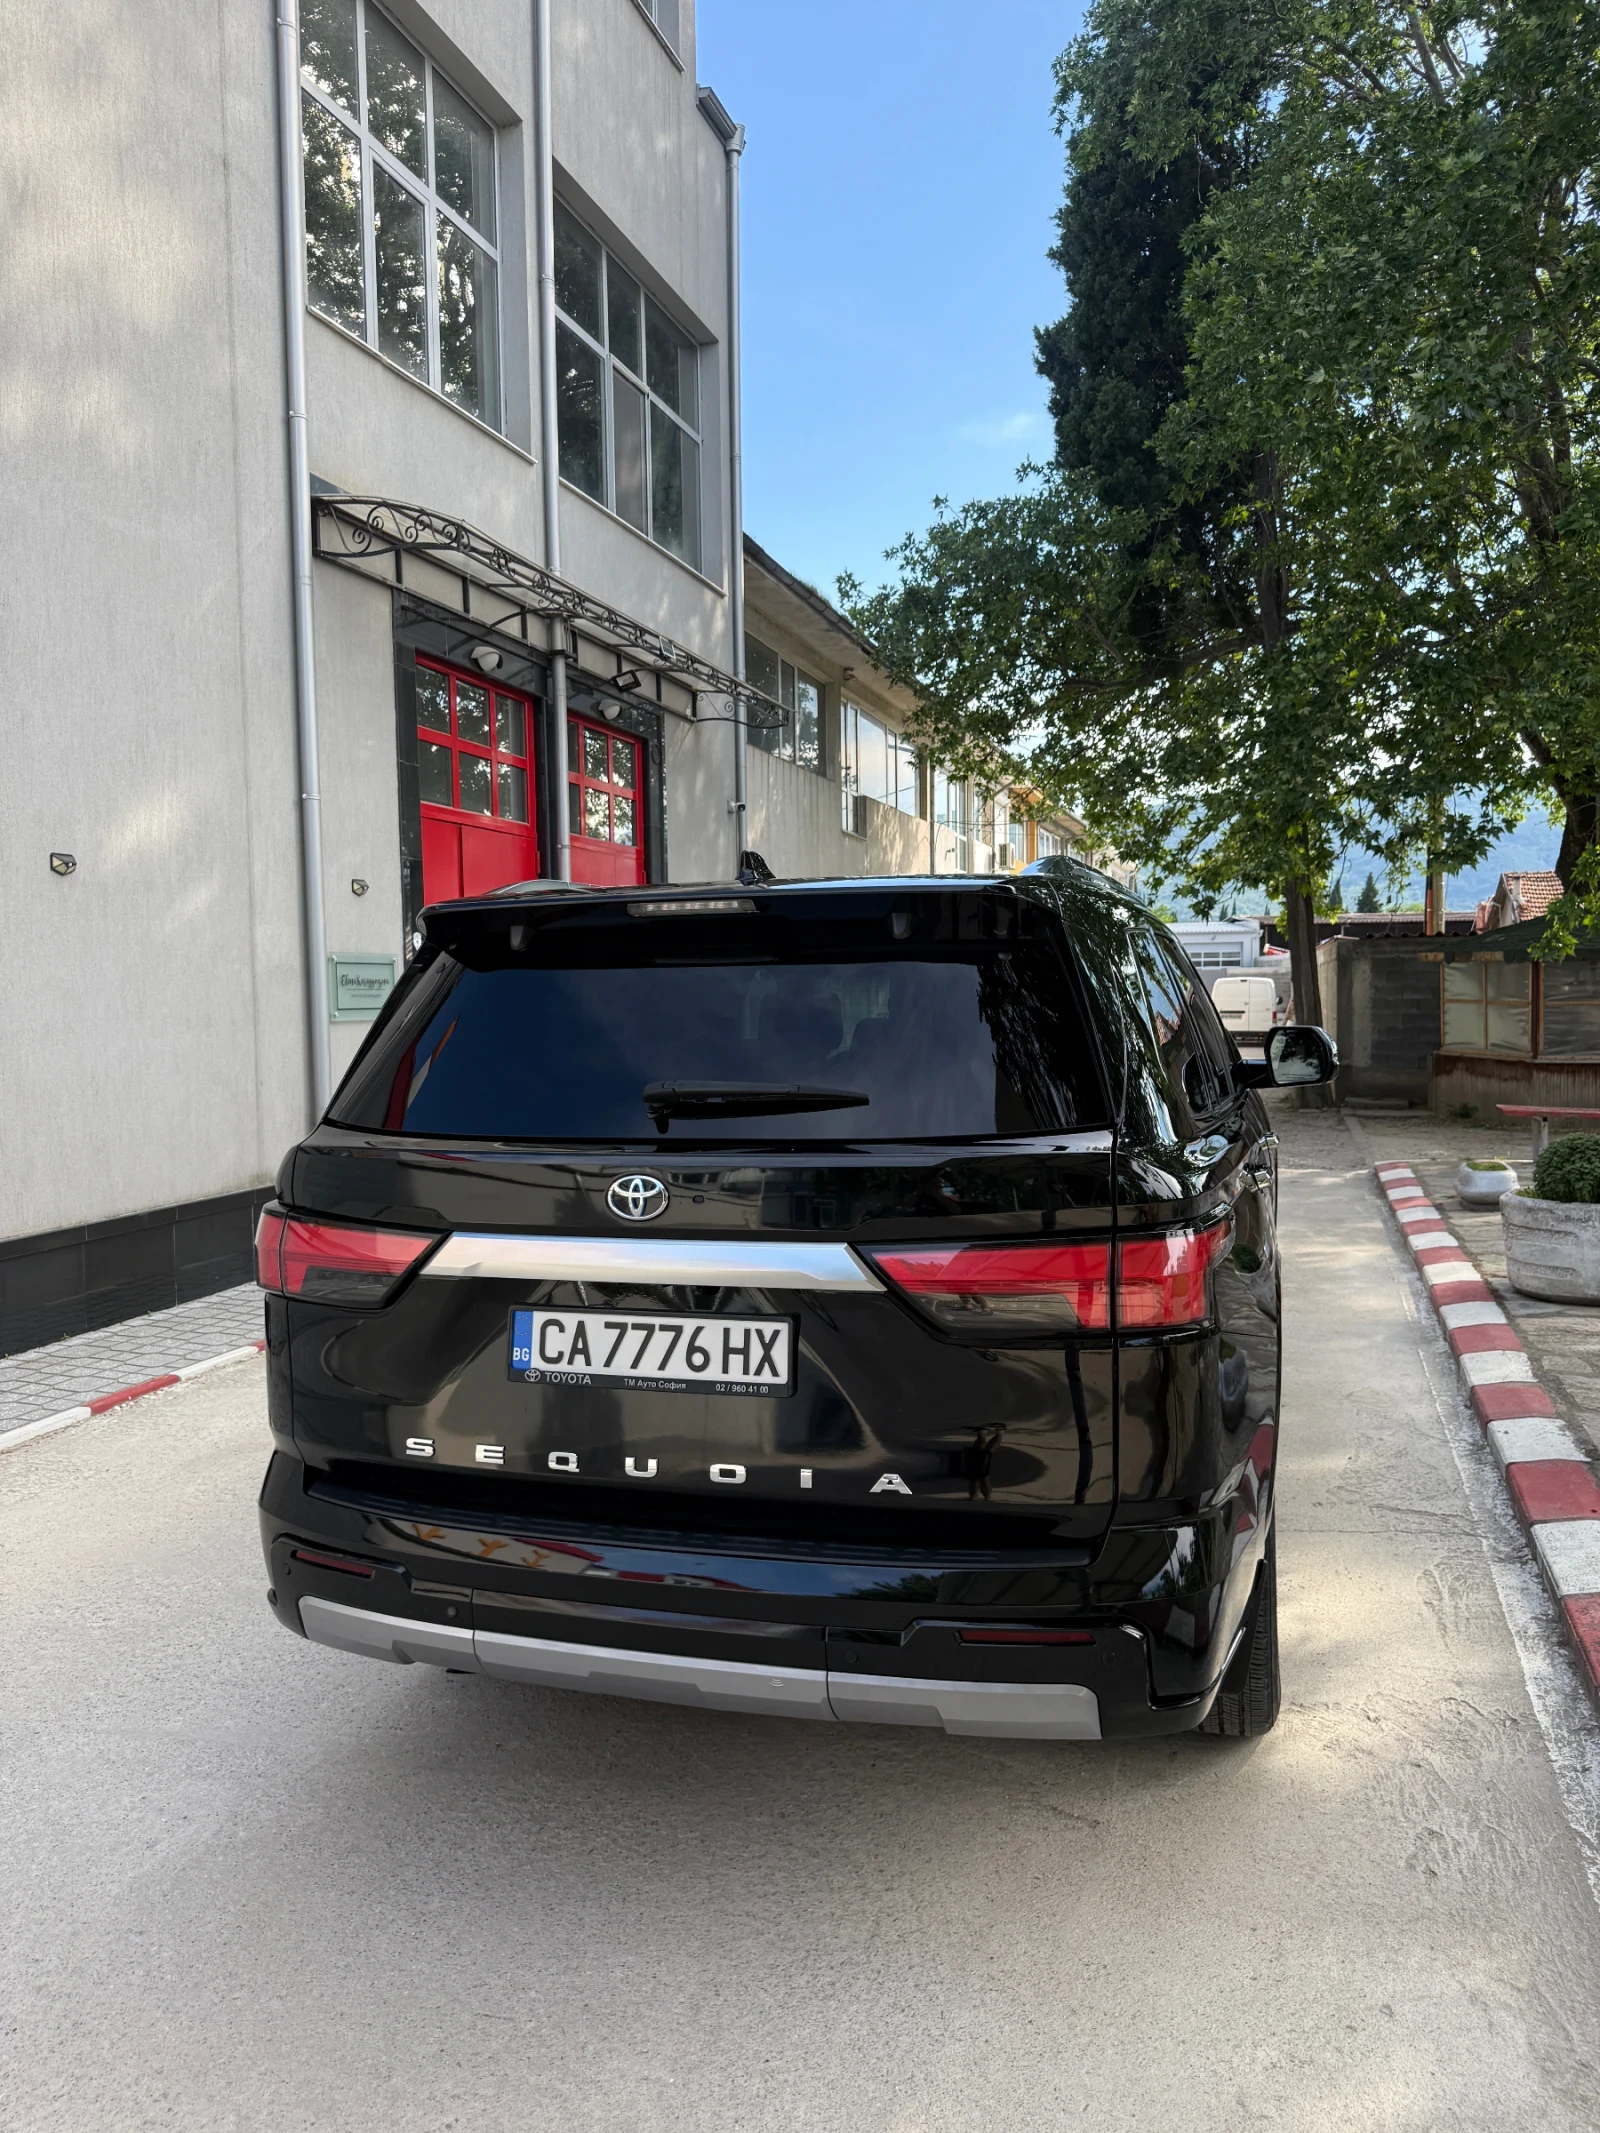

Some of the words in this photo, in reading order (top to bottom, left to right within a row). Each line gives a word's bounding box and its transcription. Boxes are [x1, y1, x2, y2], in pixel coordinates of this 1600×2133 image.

[513, 1346, 530, 1362] BG
[538, 1318, 592, 1367] CA
[602, 1321, 711, 1373] 7776
[722, 1327, 781, 1377] HX
[545, 1372, 592, 1385] TOYOTA
[637, 1380, 657, 1389] Ауто
[658, 1380, 687, 1391] София
[715, 1383, 725, 1392] 02
[731, 1384, 746, 1393] 960
[747, 1385, 758, 1393] 41
[760, 1385, 769, 1394] 00
[405, 1437, 913, 1495] SEQUOIA
